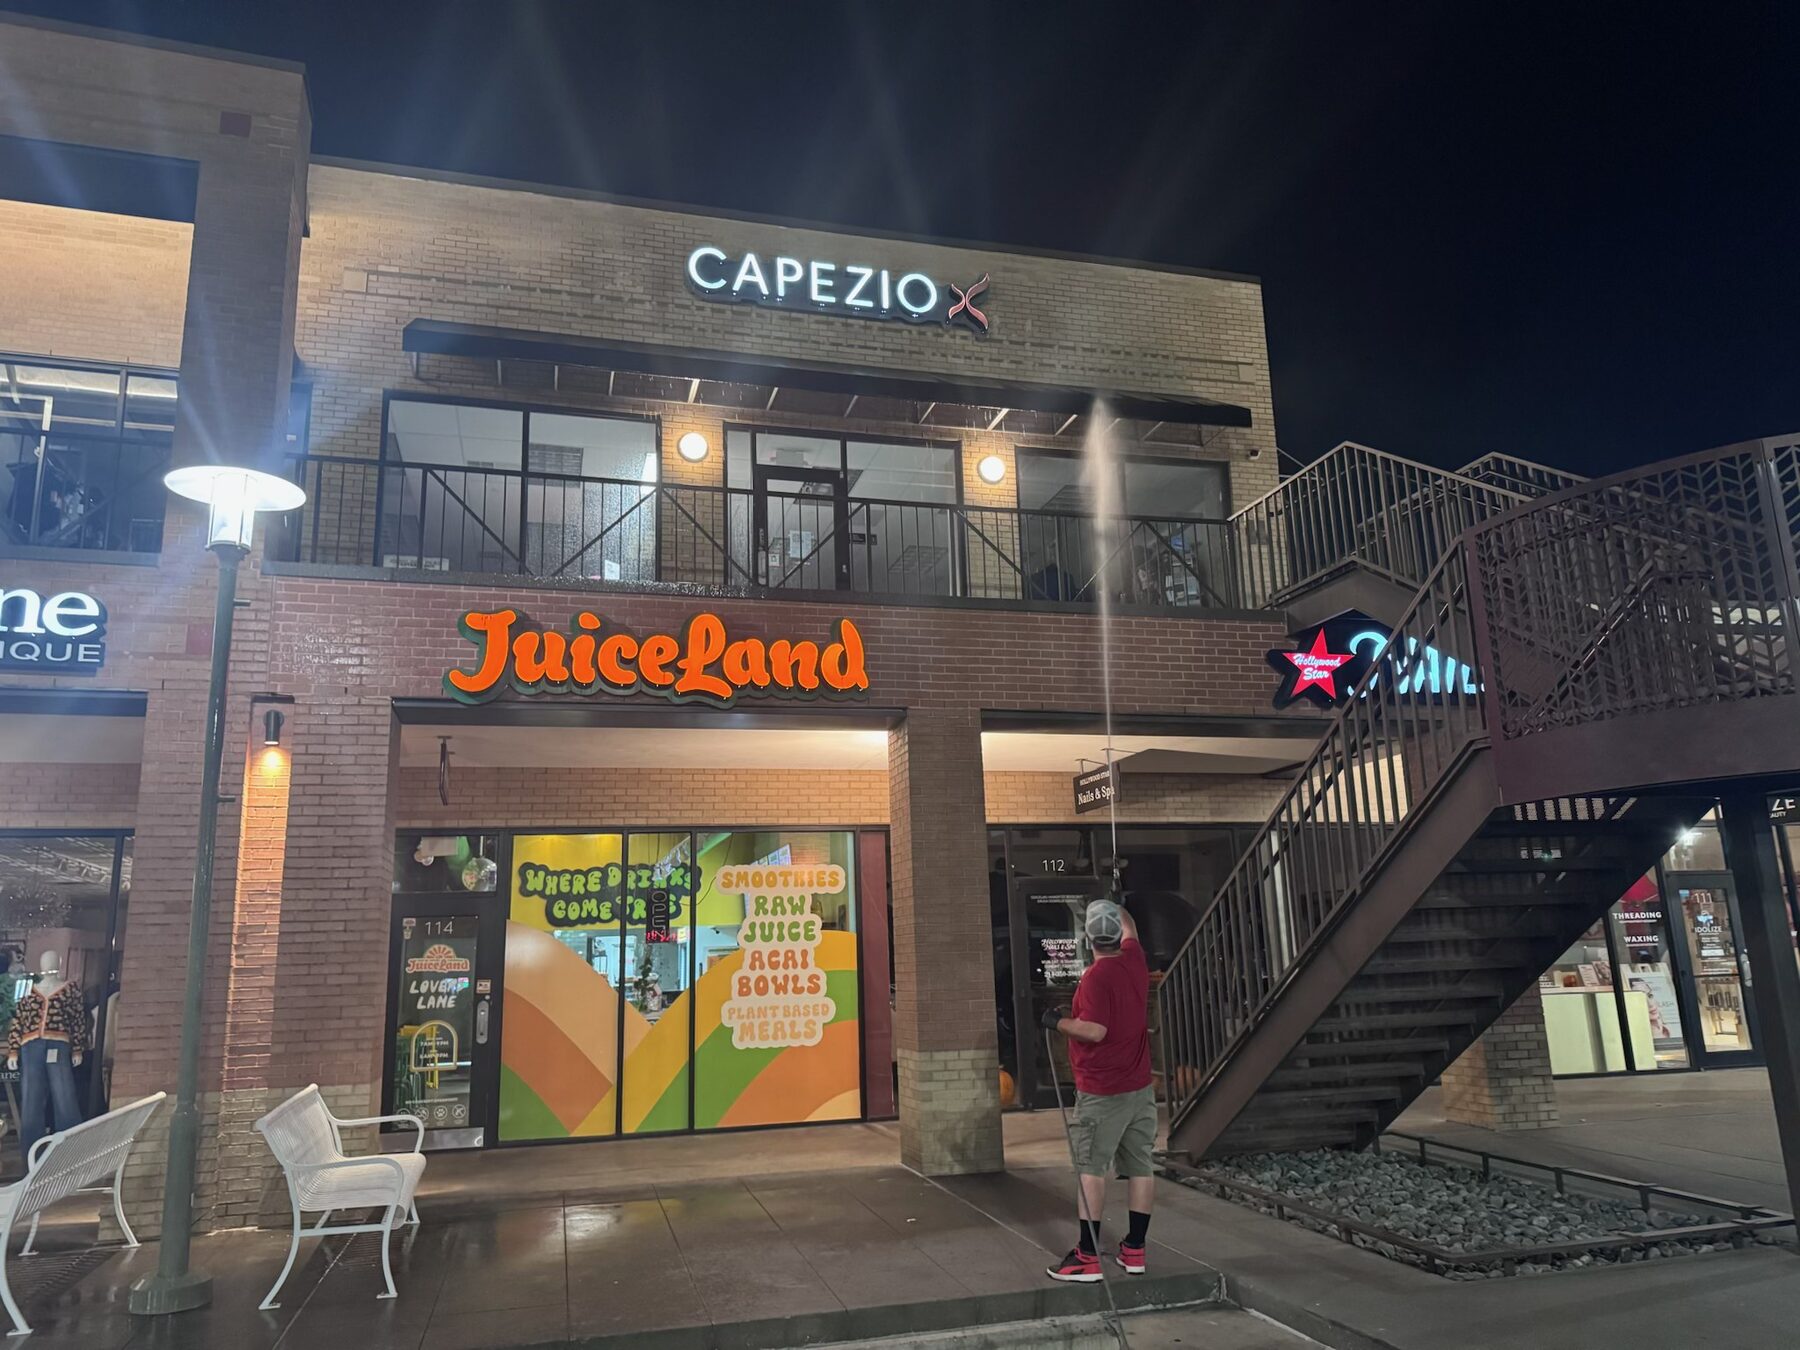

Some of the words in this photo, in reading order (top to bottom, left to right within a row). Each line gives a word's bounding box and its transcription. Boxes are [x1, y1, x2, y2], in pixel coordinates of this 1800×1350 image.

[688, 247, 938, 314] CAPEZIO
[448, 609, 870, 699] JuiceLand
[1292, 653, 1341, 670] Hollywood
[1303, 667, 1329, 681] Star
[1078, 790, 1095, 806] Nails
[1095, 787, 1101, 800] &
[1101, 785, 1115, 800] Spa
[1042, 859, 1065, 872] 112
[525, 869, 603, 896] WHERE
[721, 870, 840, 889] SMOOTHIES
[754, 895, 806, 917] RAW
[1694, 892, 1713, 904] 111
[552, 898, 613, 920] COME
[1611, 911, 1662, 920] THREADING
[425, 921, 453, 936] 114
[743, 920, 816, 943] JUICE
[1623, 935, 1659, 943] WAXING
[408, 959, 469, 972] JuiceLand
[748, 949, 809, 971] ACAI
[737, 974, 821, 997] BOWLS
[416, 995, 457, 1009] LANE
[728, 1005, 780, 1020] PLANT
[783, 1004, 830, 1018] BASED
[738, 1020, 817, 1042] MEALS
